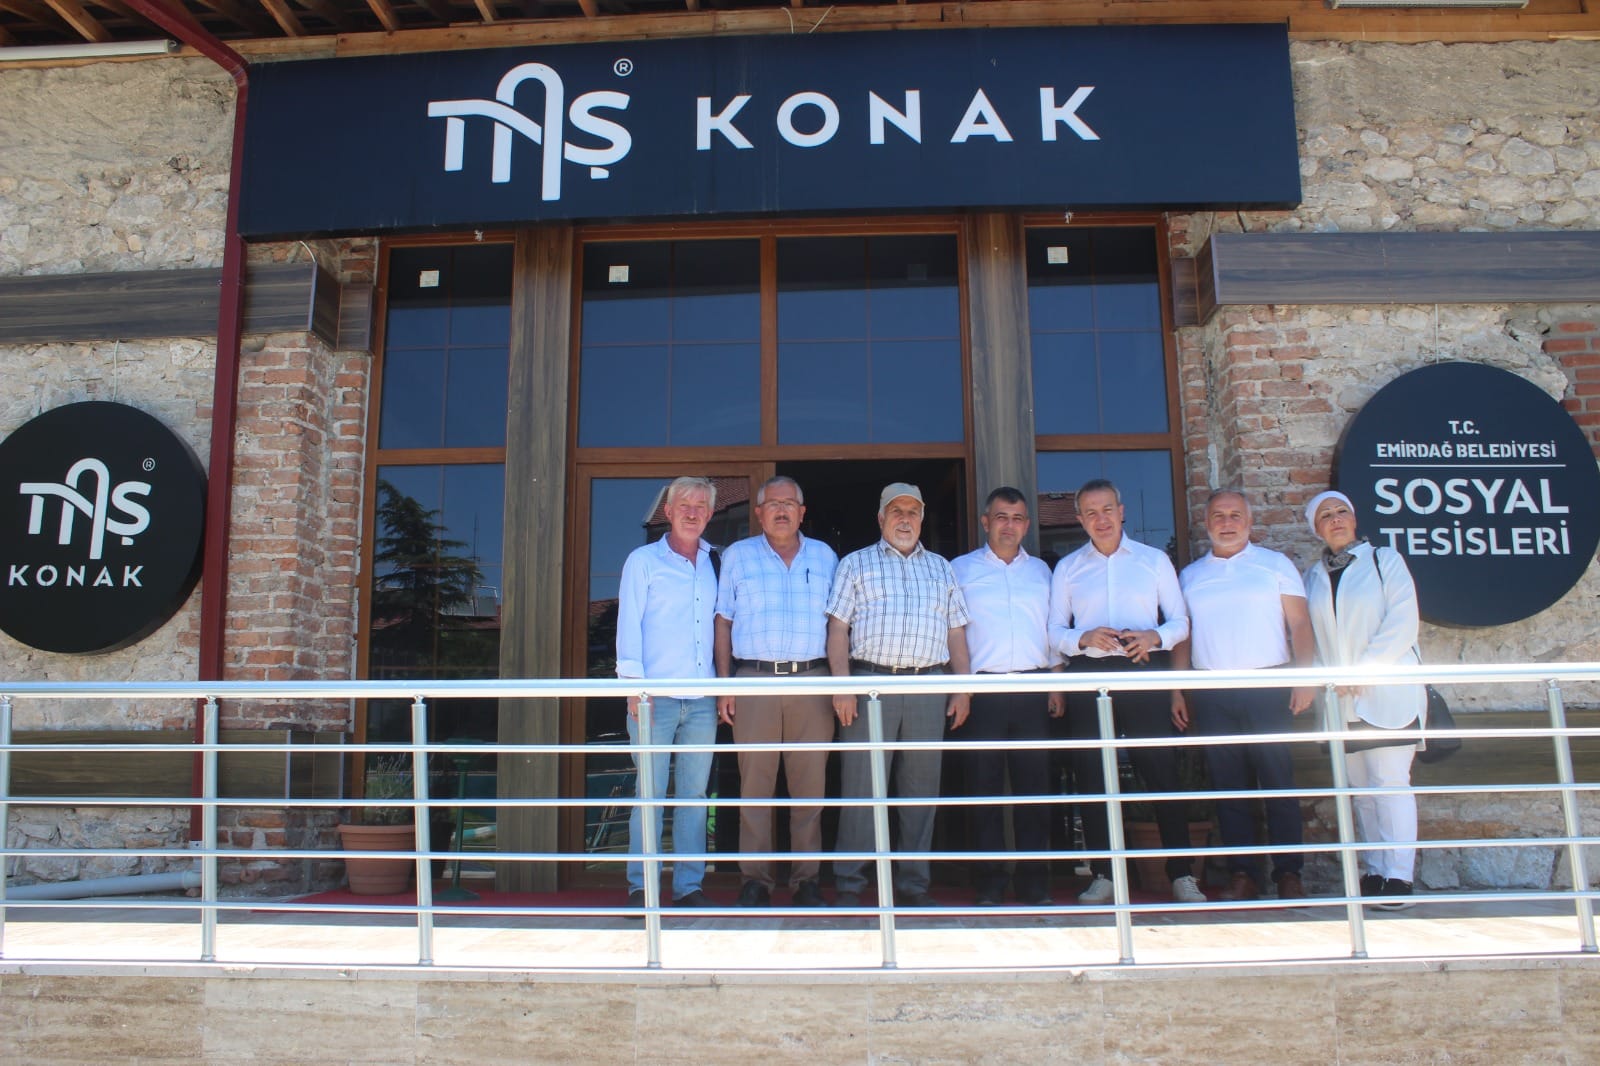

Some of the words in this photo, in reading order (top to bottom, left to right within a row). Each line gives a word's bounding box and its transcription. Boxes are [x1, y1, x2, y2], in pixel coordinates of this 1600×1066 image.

[696, 86, 1101, 151] KONAK
[1448, 420, 1480, 435] T.C.
[1376, 439, 1453, 458] EMİRDAĞ
[1456, 439, 1557, 458] BELEDİYESİ
[1374, 478, 1570, 515] SOSYAL
[1379, 519, 1571, 556] TESİSLERİ
[8, 564, 144, 587] KONAK
